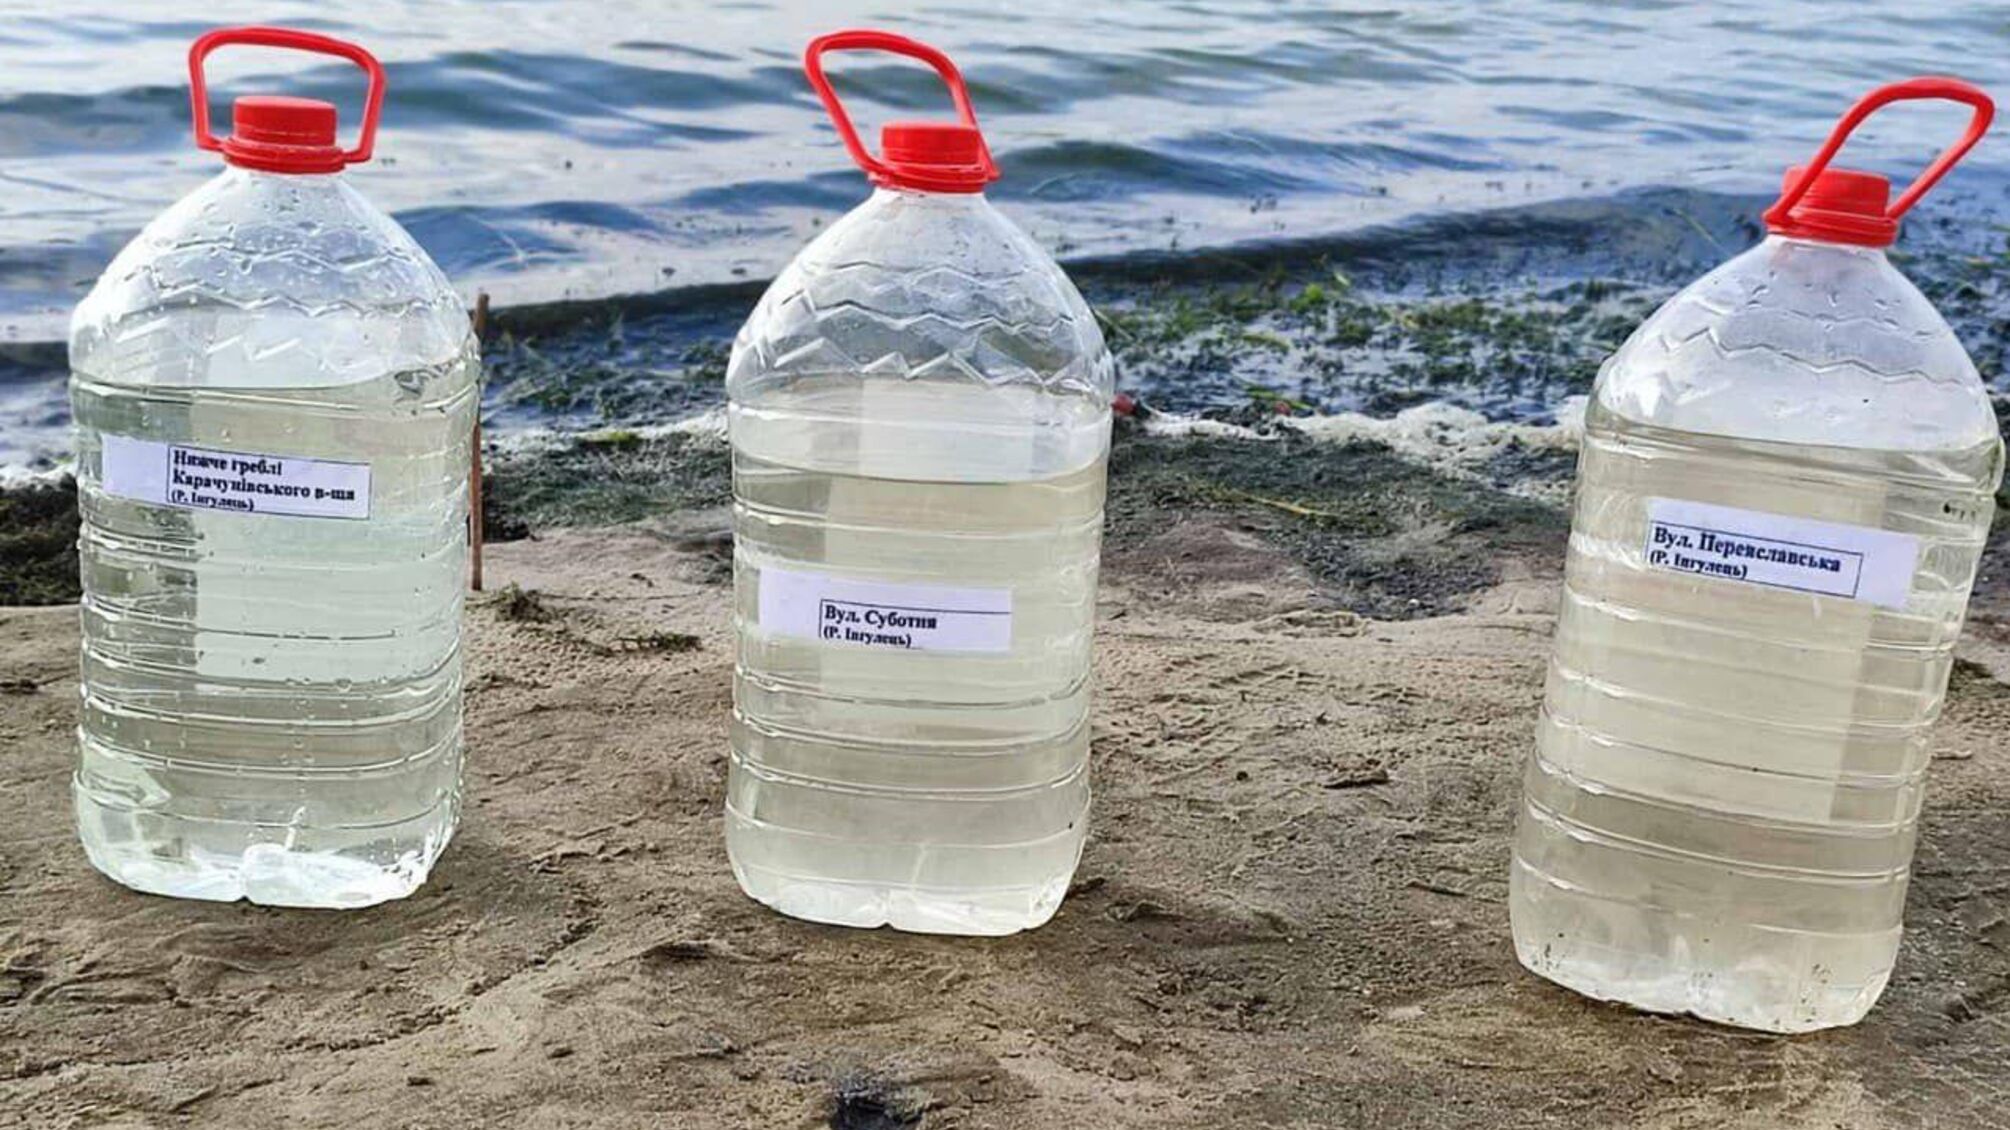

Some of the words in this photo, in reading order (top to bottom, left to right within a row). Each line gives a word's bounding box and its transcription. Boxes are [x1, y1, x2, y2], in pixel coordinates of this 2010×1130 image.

[171, 490, 189, 505] (Р.
[1653, 526, 1693, 549] Вул.
[1649, 550, 1669, 565] (Р.
[824, 604, 860, 624] Вул.
[823, 626, 842, 640] (Р.
